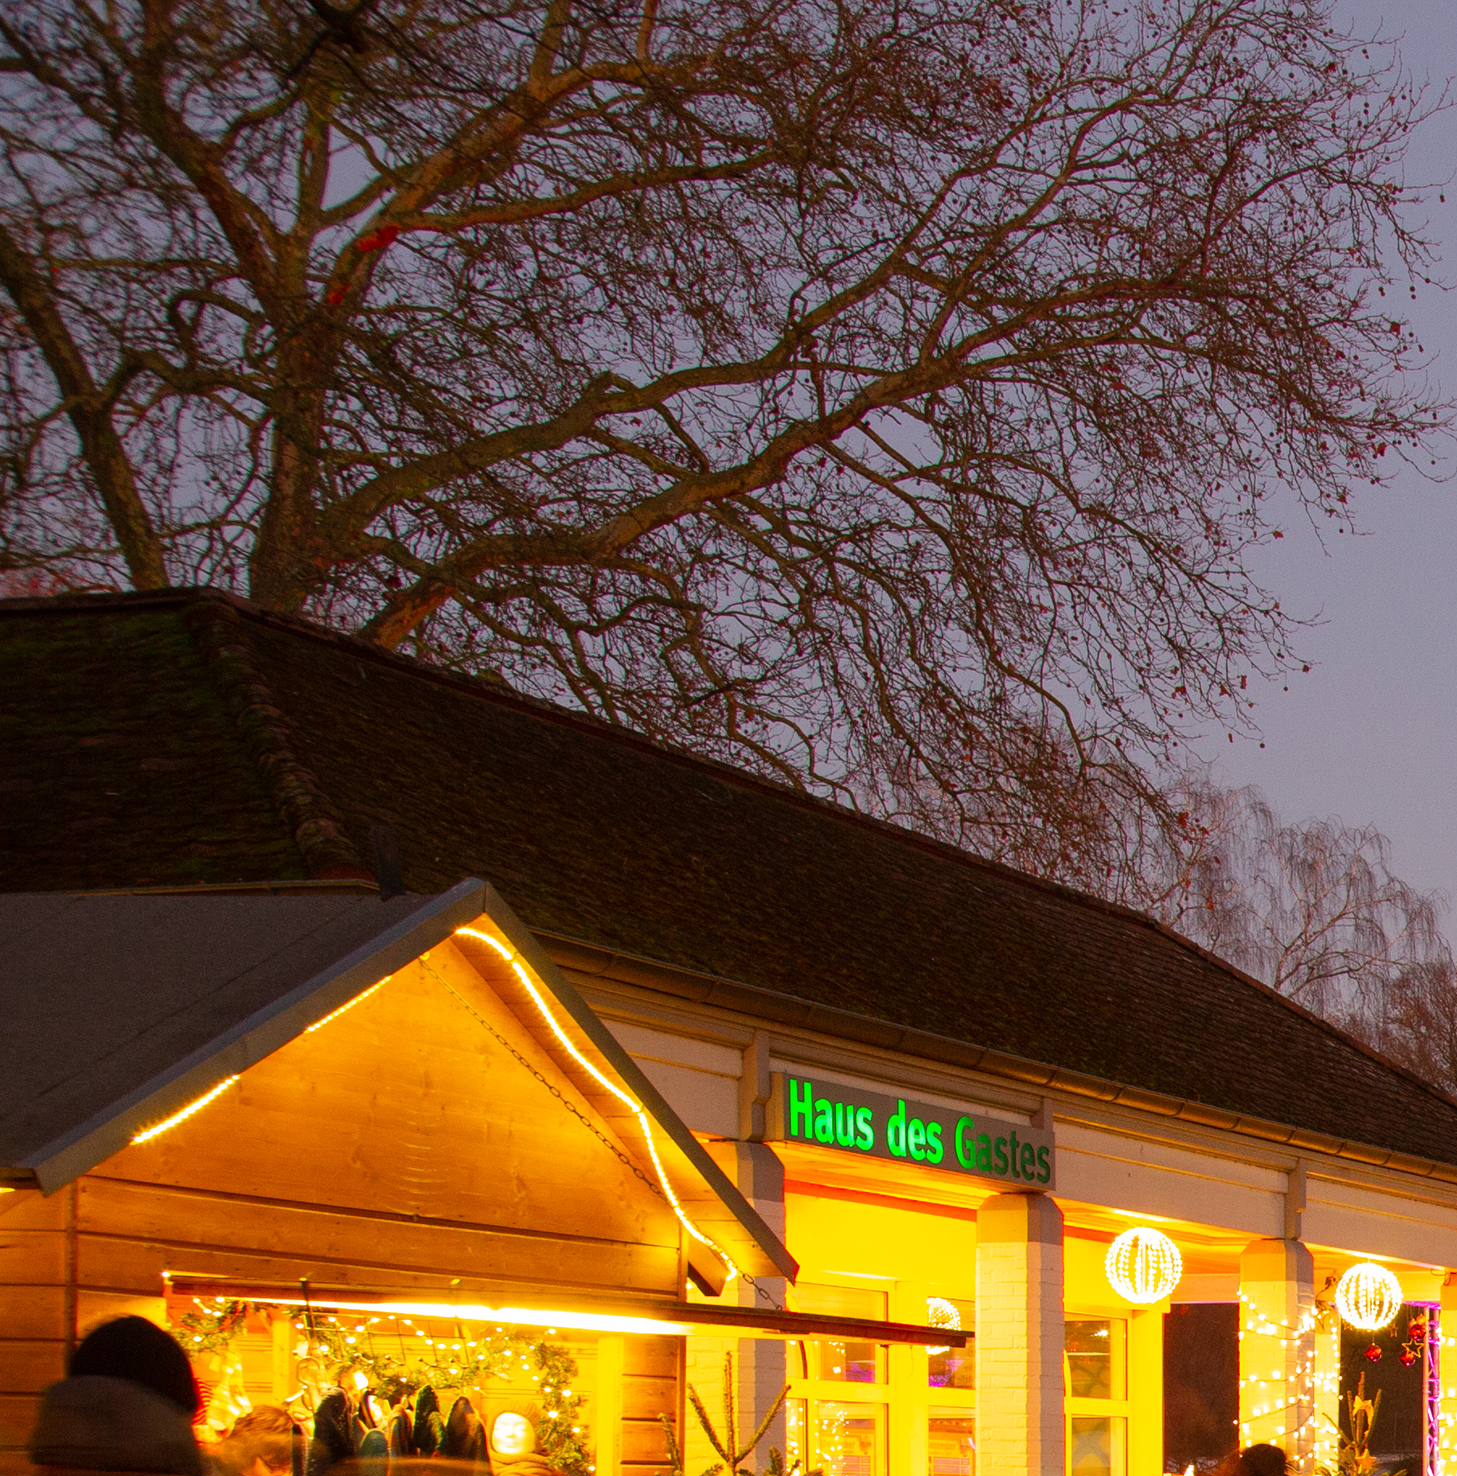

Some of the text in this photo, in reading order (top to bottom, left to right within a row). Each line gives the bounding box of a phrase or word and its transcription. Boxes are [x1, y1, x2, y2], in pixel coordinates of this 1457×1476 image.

[789, 1078, 1051, 1184] Haus des Gastes
